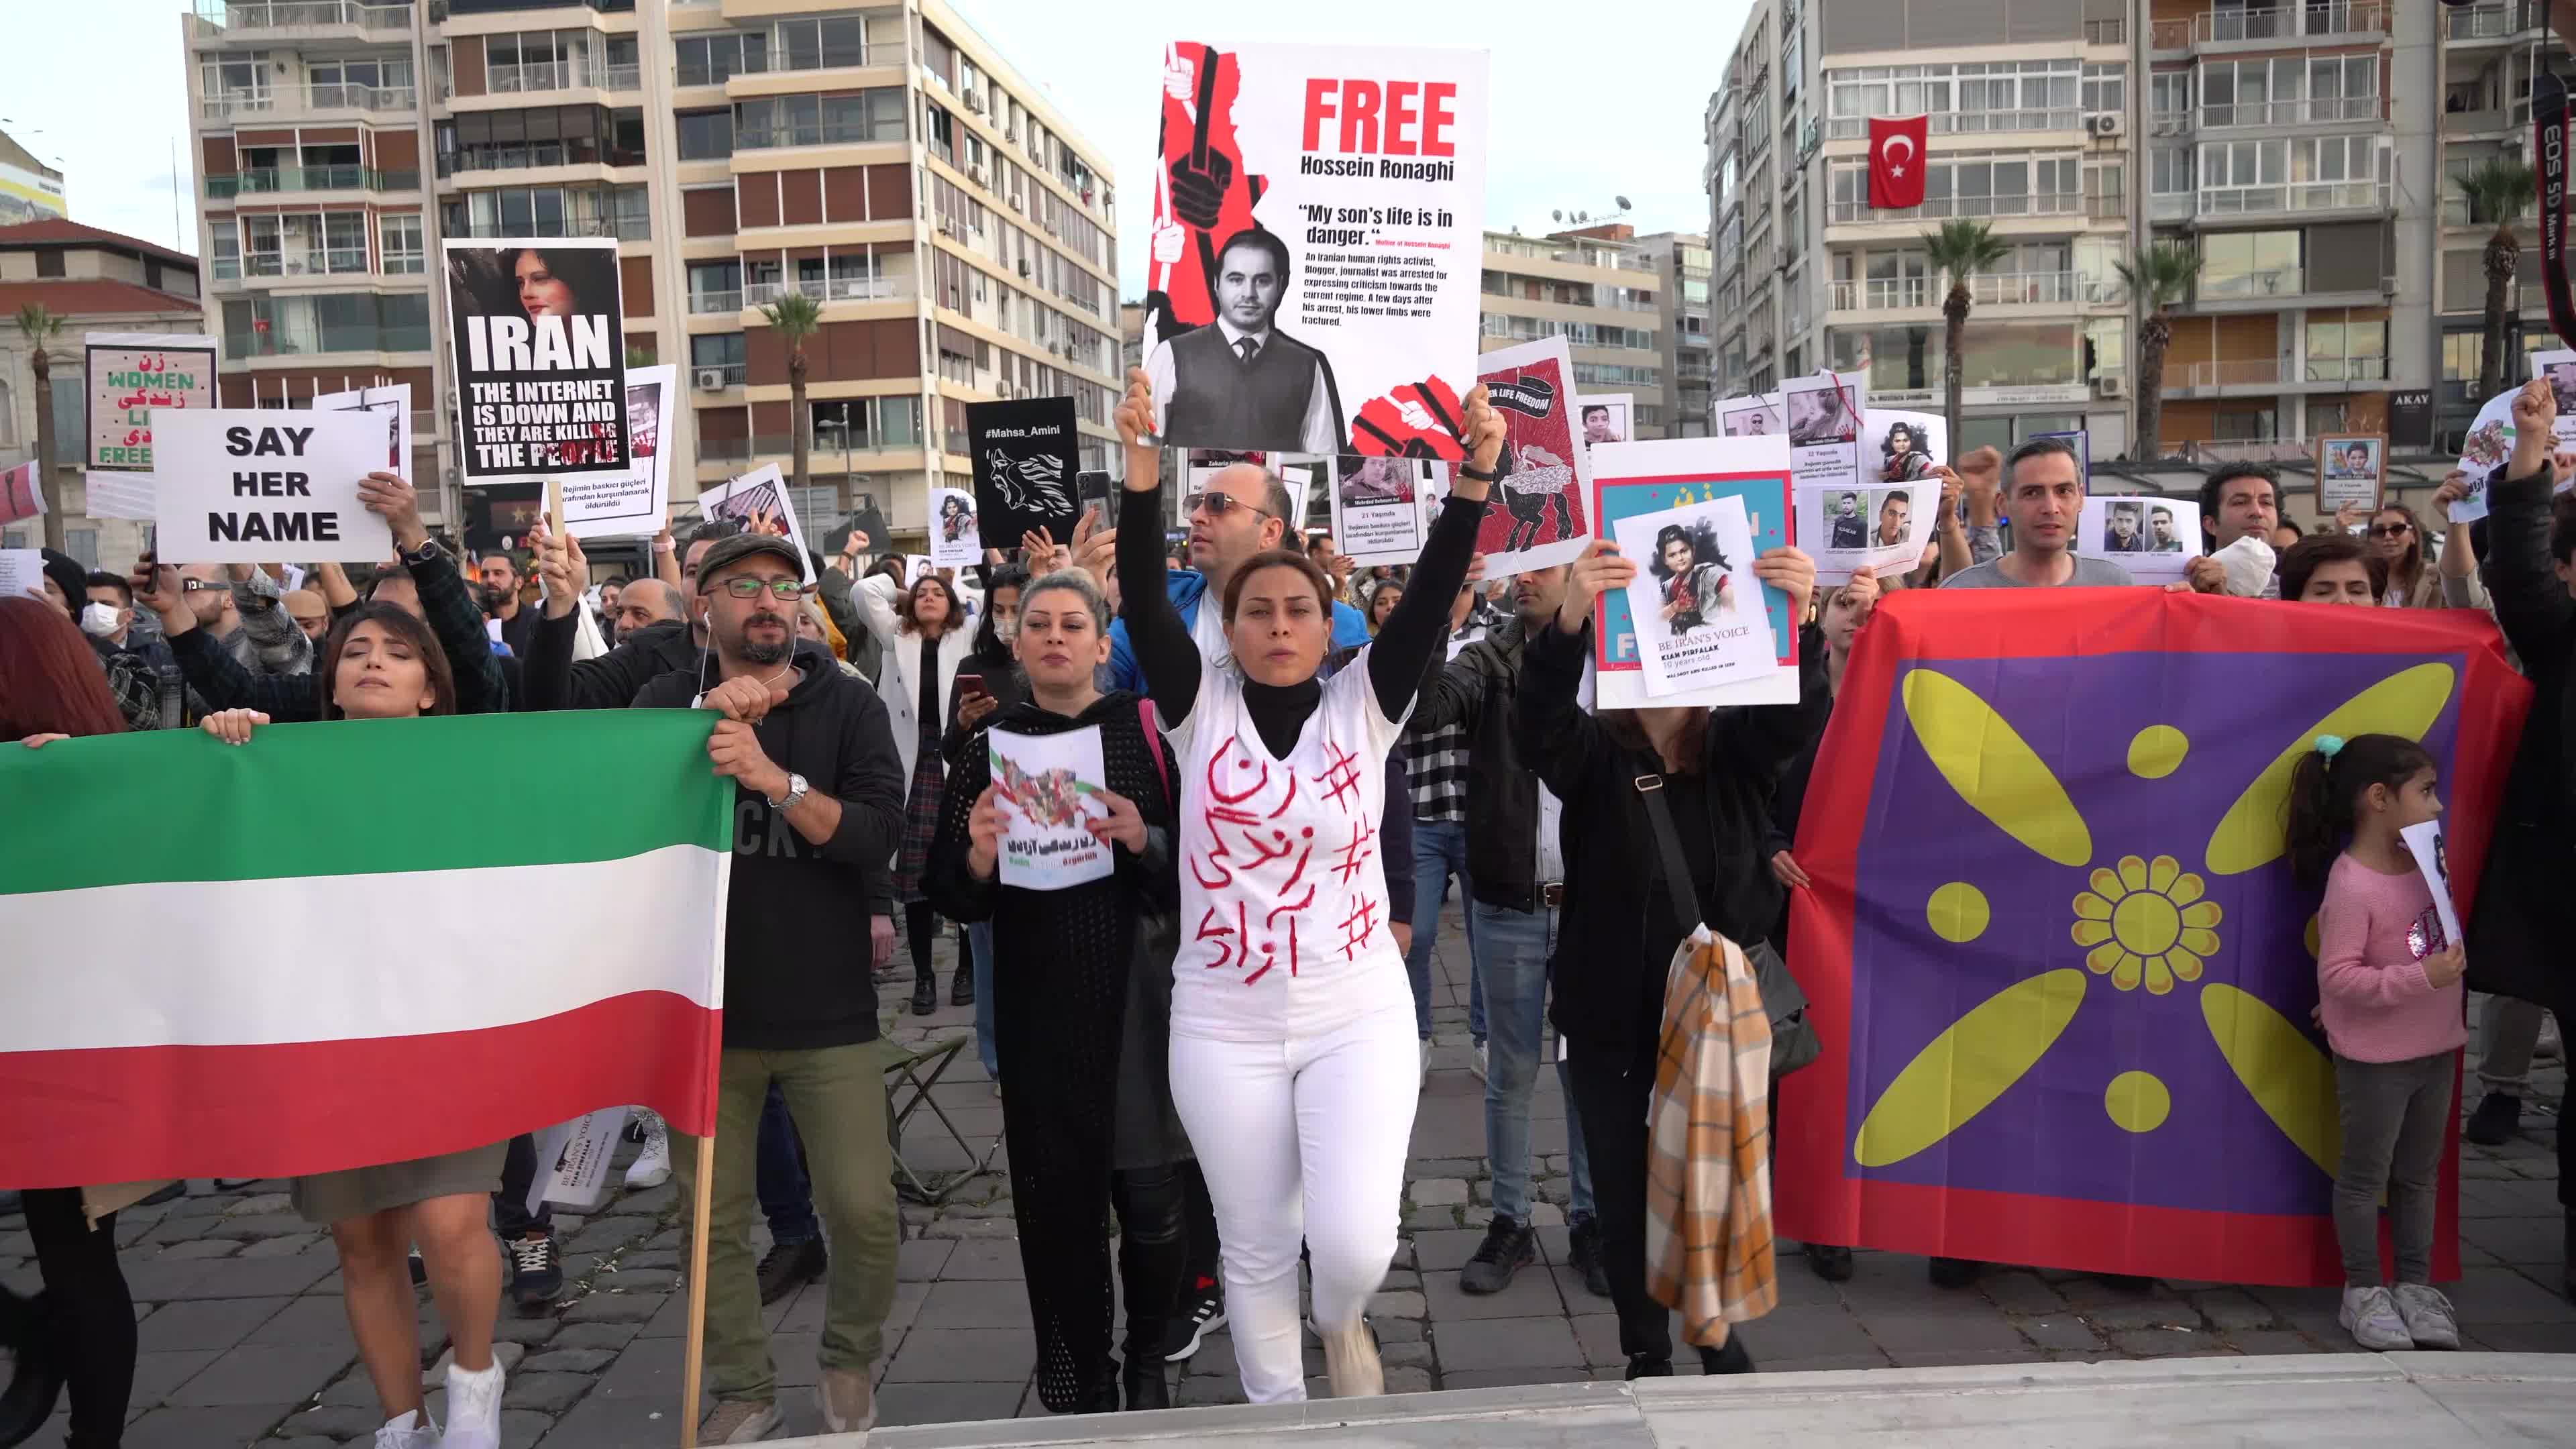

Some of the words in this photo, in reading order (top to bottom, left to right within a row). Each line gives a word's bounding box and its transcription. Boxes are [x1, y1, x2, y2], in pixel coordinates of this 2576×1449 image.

[1302, 78, 1456, 156] FREE
[2544, 125, 2562, 177] EOS
[1301, 156, 1374, 177] Hossein
[1380, 160, 1454, 182] Ronaghi
[2548, 182, 2561, 207] 5D
[1299, 204, 1332, 225] “My
[1338, 207, 1383, 225] son’s
[1387, 207, 1412, 225] life
[1417, 208, 1432, 227] is
[1438, 209, 1452, 227] in
[2548, 213, 2557, 247] Mark
[1375, 239, 1395, 247] Mother
[1428, 241, 1450, 250] Ronaghi
[1305, 253, 1316, 262] An
[1318, 253, 1346, 262] Iranian
[1348, 254, 1375, 264] human
[1377, 254, 1401, 266] rights
[1403, 256, 1436, 268] activist,
[1305, 265, 1338, 276] Blogger,
[1340, 266, 1379, 277] journalist
[1381, 269, 1397, 278] was
[1399, 269, 1434, 279] arrested
[1436, 270, 1448, 280] for
[1304, 278, 1349, 290] expressing
[1351, 280, 1387, 290] criticism
[1389, 282, 1422, 291] towards
[1425, 282, 1438, 292] the
[1303, 291, 1333, 301] current
[1335, 292, 1366, 302] regime.
[1368, 293, 1373, 302] A
[1375, 293, 1390, 303] few
[1393, 294, 1411, 305] days
[1413, 295, 1433, 305] after
[1302, 303, 1315, 312] his
[1317, 304, 1344, 315] arrest,
[1346, 305, 1359, 315] his
[1361, 305, 1383, 315] lower
[1386, 307, 1408, 317] limbs
[1411, 308, 1431, 317] were
[1302, 315, 1342, 326] fractured.
[467, 315, 610, 371] IRAN
[139, 354, 165, 372] زن
[108, 371, 194, 389] WOMEN
[470, 382, 512, 403] THE
[516, 380, 614, 402] INTERNET
[1499, 388, 1515, 399] LIFE
[1515, 391, 1549, 410] FREEDOM
[2395, 394, 2429, 405] AKAY
[129, 410, 148, 425] LI
[473, 405, 496, 425] IS
[500, 403, 568, 425] DOWN
[573, 402, 616, 422] AND
[474, 426, 515, 443] THEY
[521, 425, 551, 442] ARE
[555, 423, 616, 440] KILLING
[985, 424, 1060, 439] #Mahsa_Amini
[225, 427, 315, 456] SAY
[99, 447, 151, 464] FREE
[476, 443, 525, 468] THE
[531, 439, 619, 468] PEOPLE
[233, 472, 311, 496] HER
[563, 484, 591, 494] Rejimin
[592, 482, 619, 490] baskıcı
[621, 478, 645, 489] güçleri
[562, 494, 595, 503] arafından
[597, 488, 649, 499] kurşunlanarak
[585, 500, 620, 509] öldürüldü
[209, 512, 339, 541] NAME
[1658, 641, 1672, 651] BE
[1675, 633, 1711, 649] IRAN'S
[1713, 627, 1750, 639] VOICE
[1682, 644, 1719, 657] PIRFALAK
[1674, 657, 1695, 668] years
